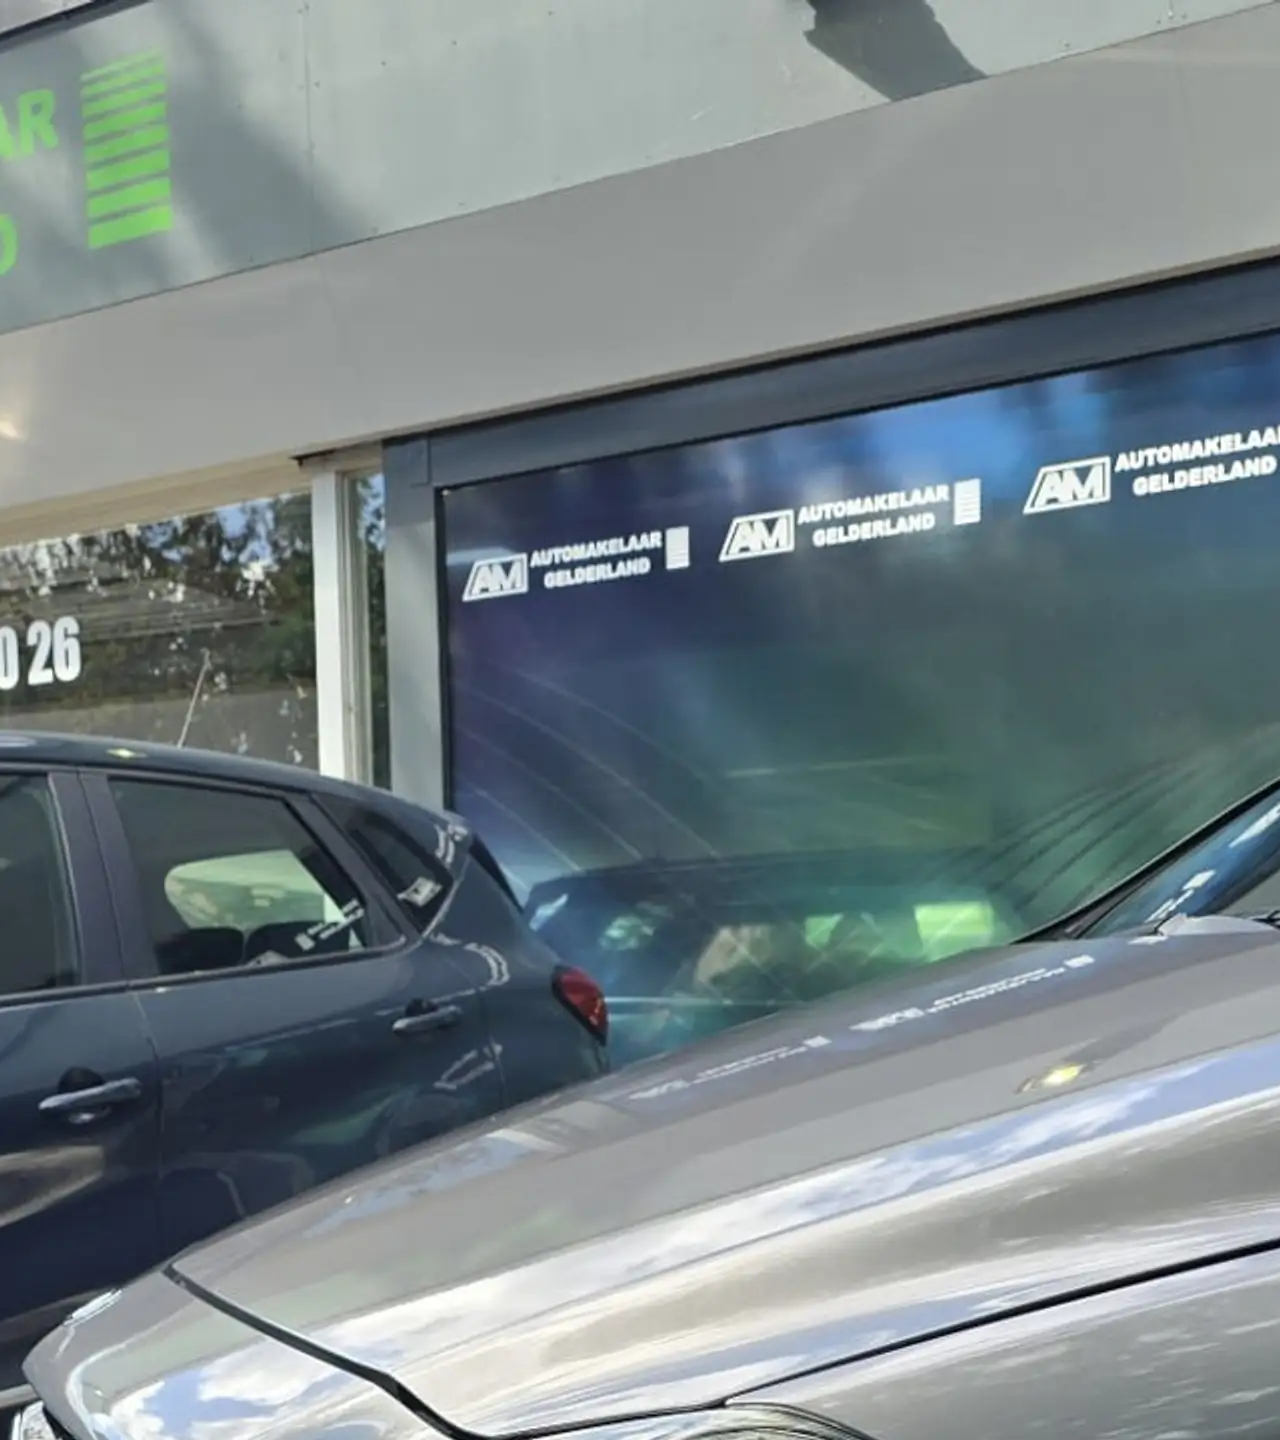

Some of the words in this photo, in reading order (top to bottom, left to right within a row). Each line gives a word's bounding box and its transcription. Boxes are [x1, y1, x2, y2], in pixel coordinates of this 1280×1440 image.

[1034, 462, 1103, 508] AM
[1132, 455, 1277, 496] GELDERLAND
[797, 484, 949, 525] AUTOMAKELAAR
[530, 531, 663, 568] AUTOMAKELAAR
[728, 516, 788, 556] AM
[812, 513, 936, 547] GELDERLAND
[471, 559, 521, 597] AM
[544, 557, 651, 589] GELDERLAND
[26, 616, 82, 686] 26
